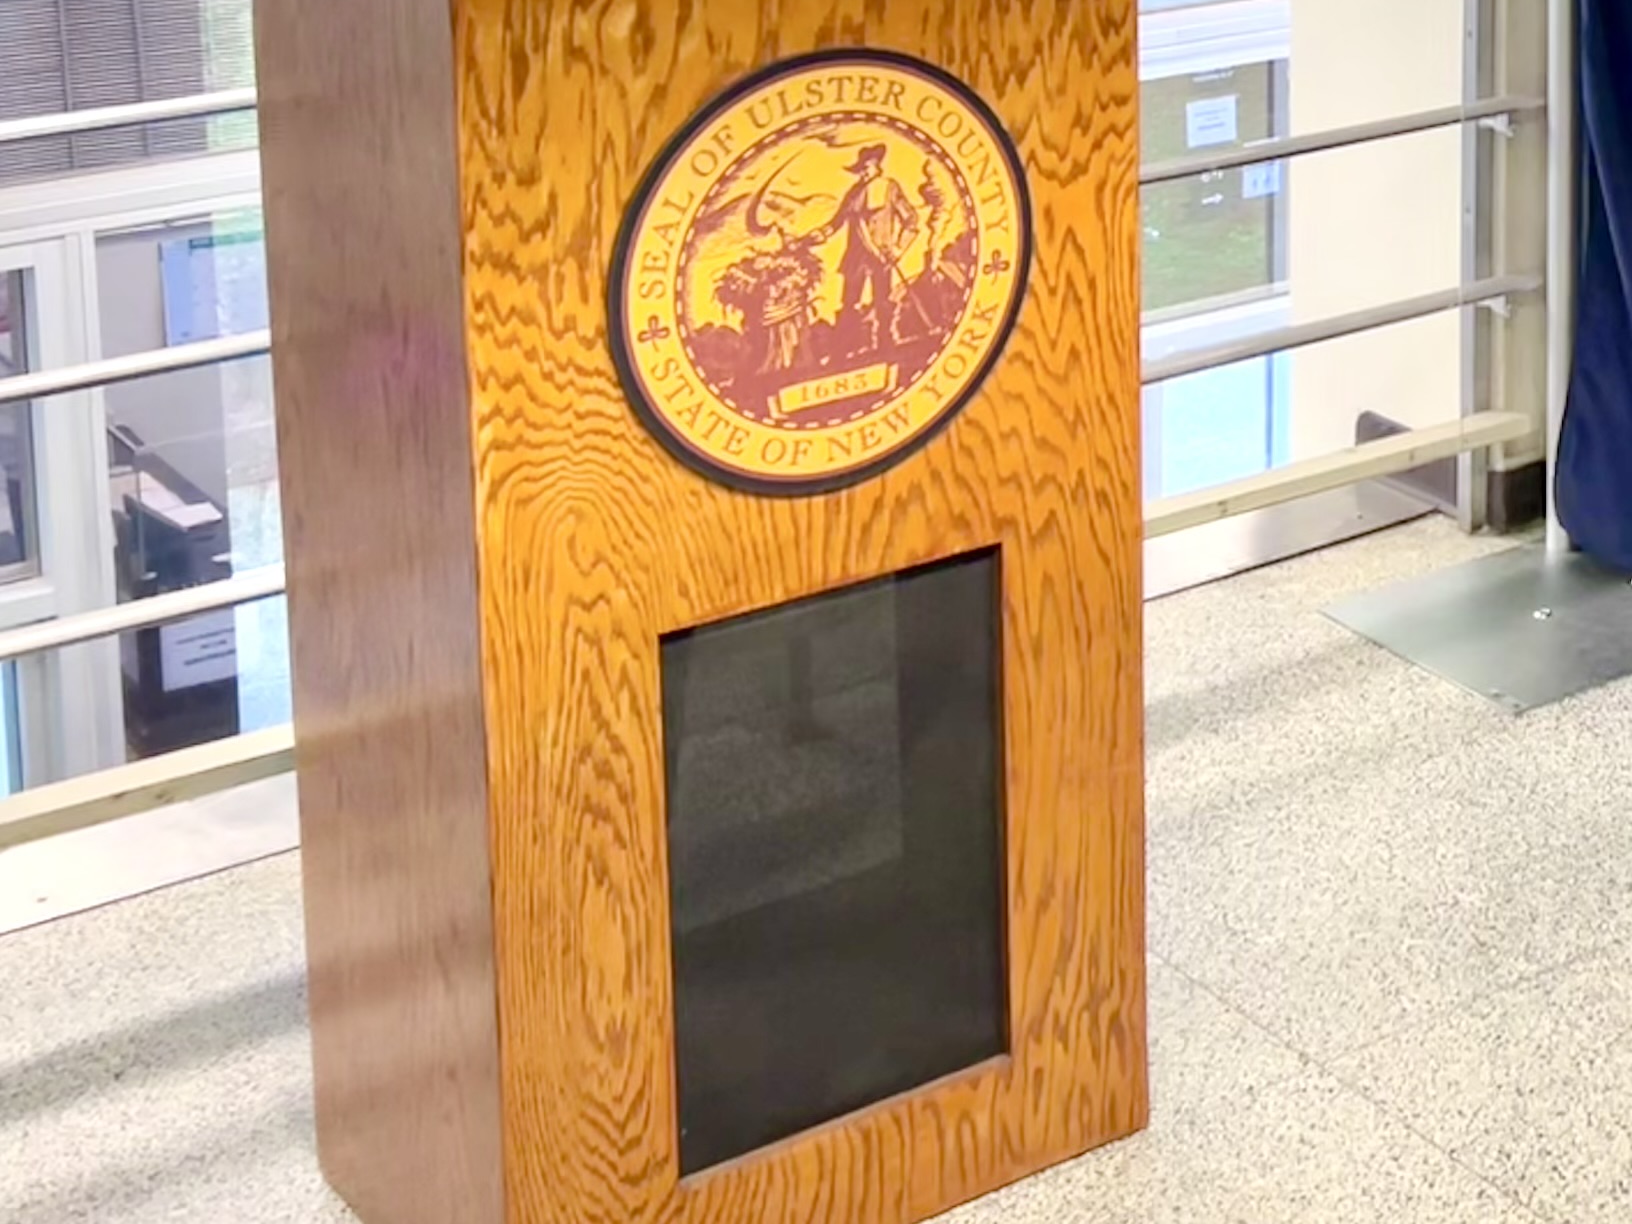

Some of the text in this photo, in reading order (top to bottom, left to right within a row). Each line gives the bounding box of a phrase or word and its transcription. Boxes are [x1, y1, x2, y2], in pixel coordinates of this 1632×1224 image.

[639, 76, 1009, 299] SEAL OF ULSTER COUNTY
[650, 299, 999, 466] STATE OF NEW YORK
[801, 373, 868, 402] 1683
